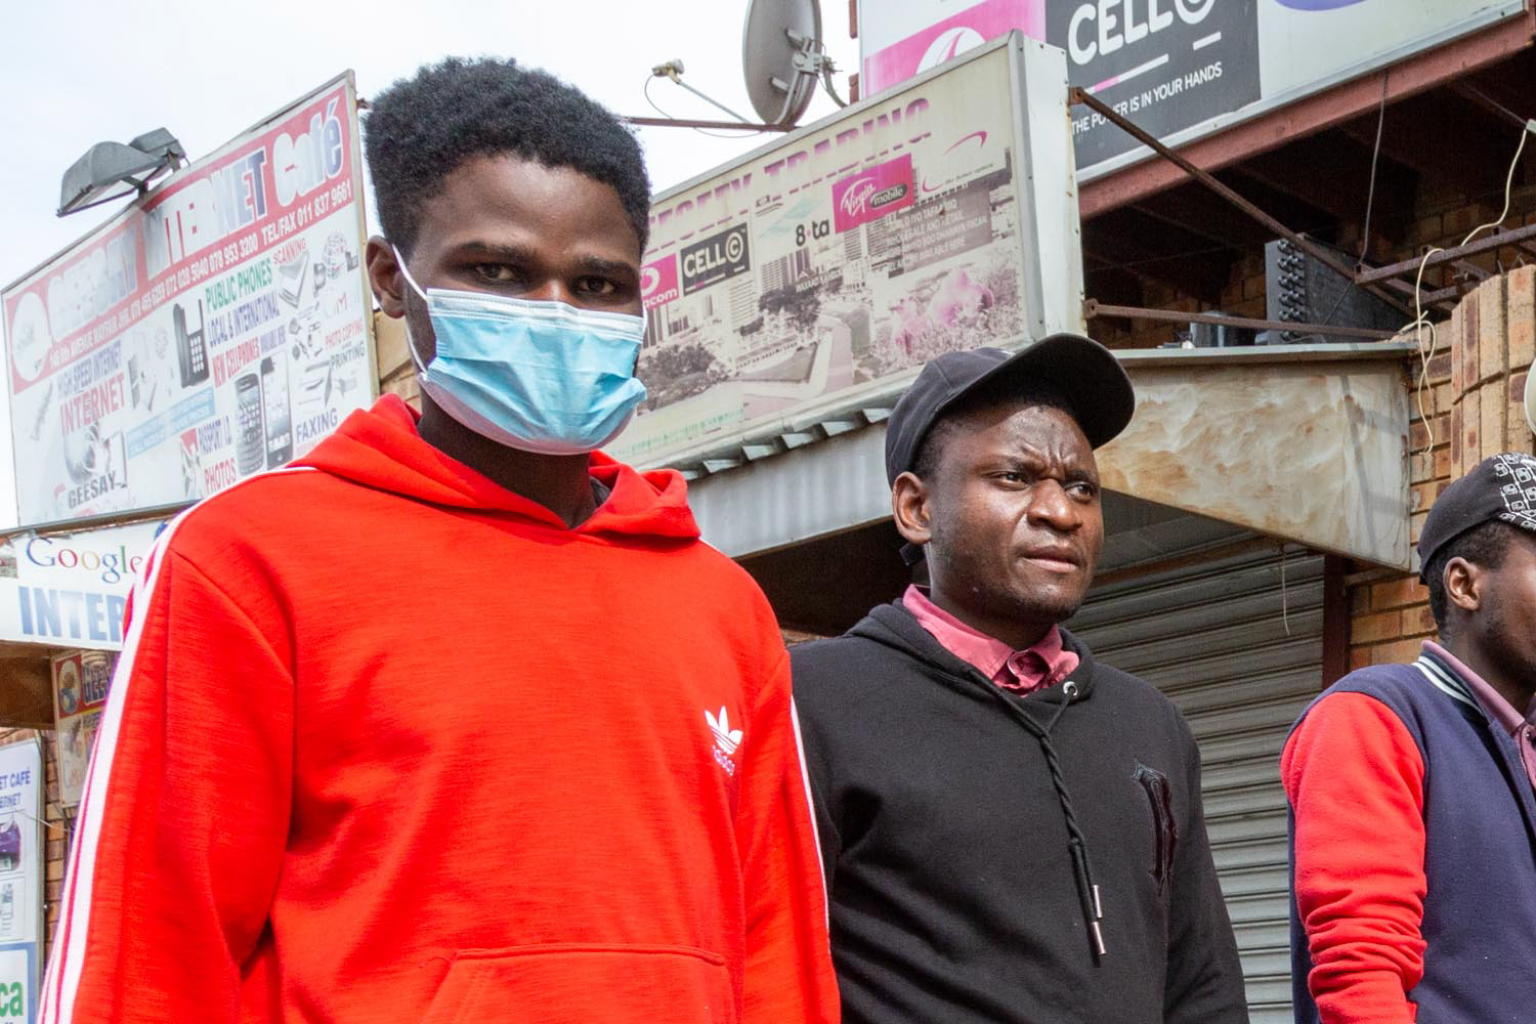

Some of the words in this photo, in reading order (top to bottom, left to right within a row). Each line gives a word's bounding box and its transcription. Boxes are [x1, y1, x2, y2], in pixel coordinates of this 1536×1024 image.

[1072, 115, 1090, 135] THE
[1091, 102, 1128, 127] POER
[1129, 96, 1140, 112] IS
[1141, 92, 1152, 108] IN
[1153, 81, 1183, 102] YOUR
[1184, 61, 1223, 90] HANDS
[272, 96, 345, 206] Café
[841, 180, 876, 217] Virgin
[874, 187, 903, 206] mobile
[205, 273, 236, 311] PUBLIC
[237, 257, 272, 296] PHONES
[59, 372, 126, 436] INTERNET
[295, 408, 338, 444] FAXING
[204, 457, 237, 495] PHOTOS
